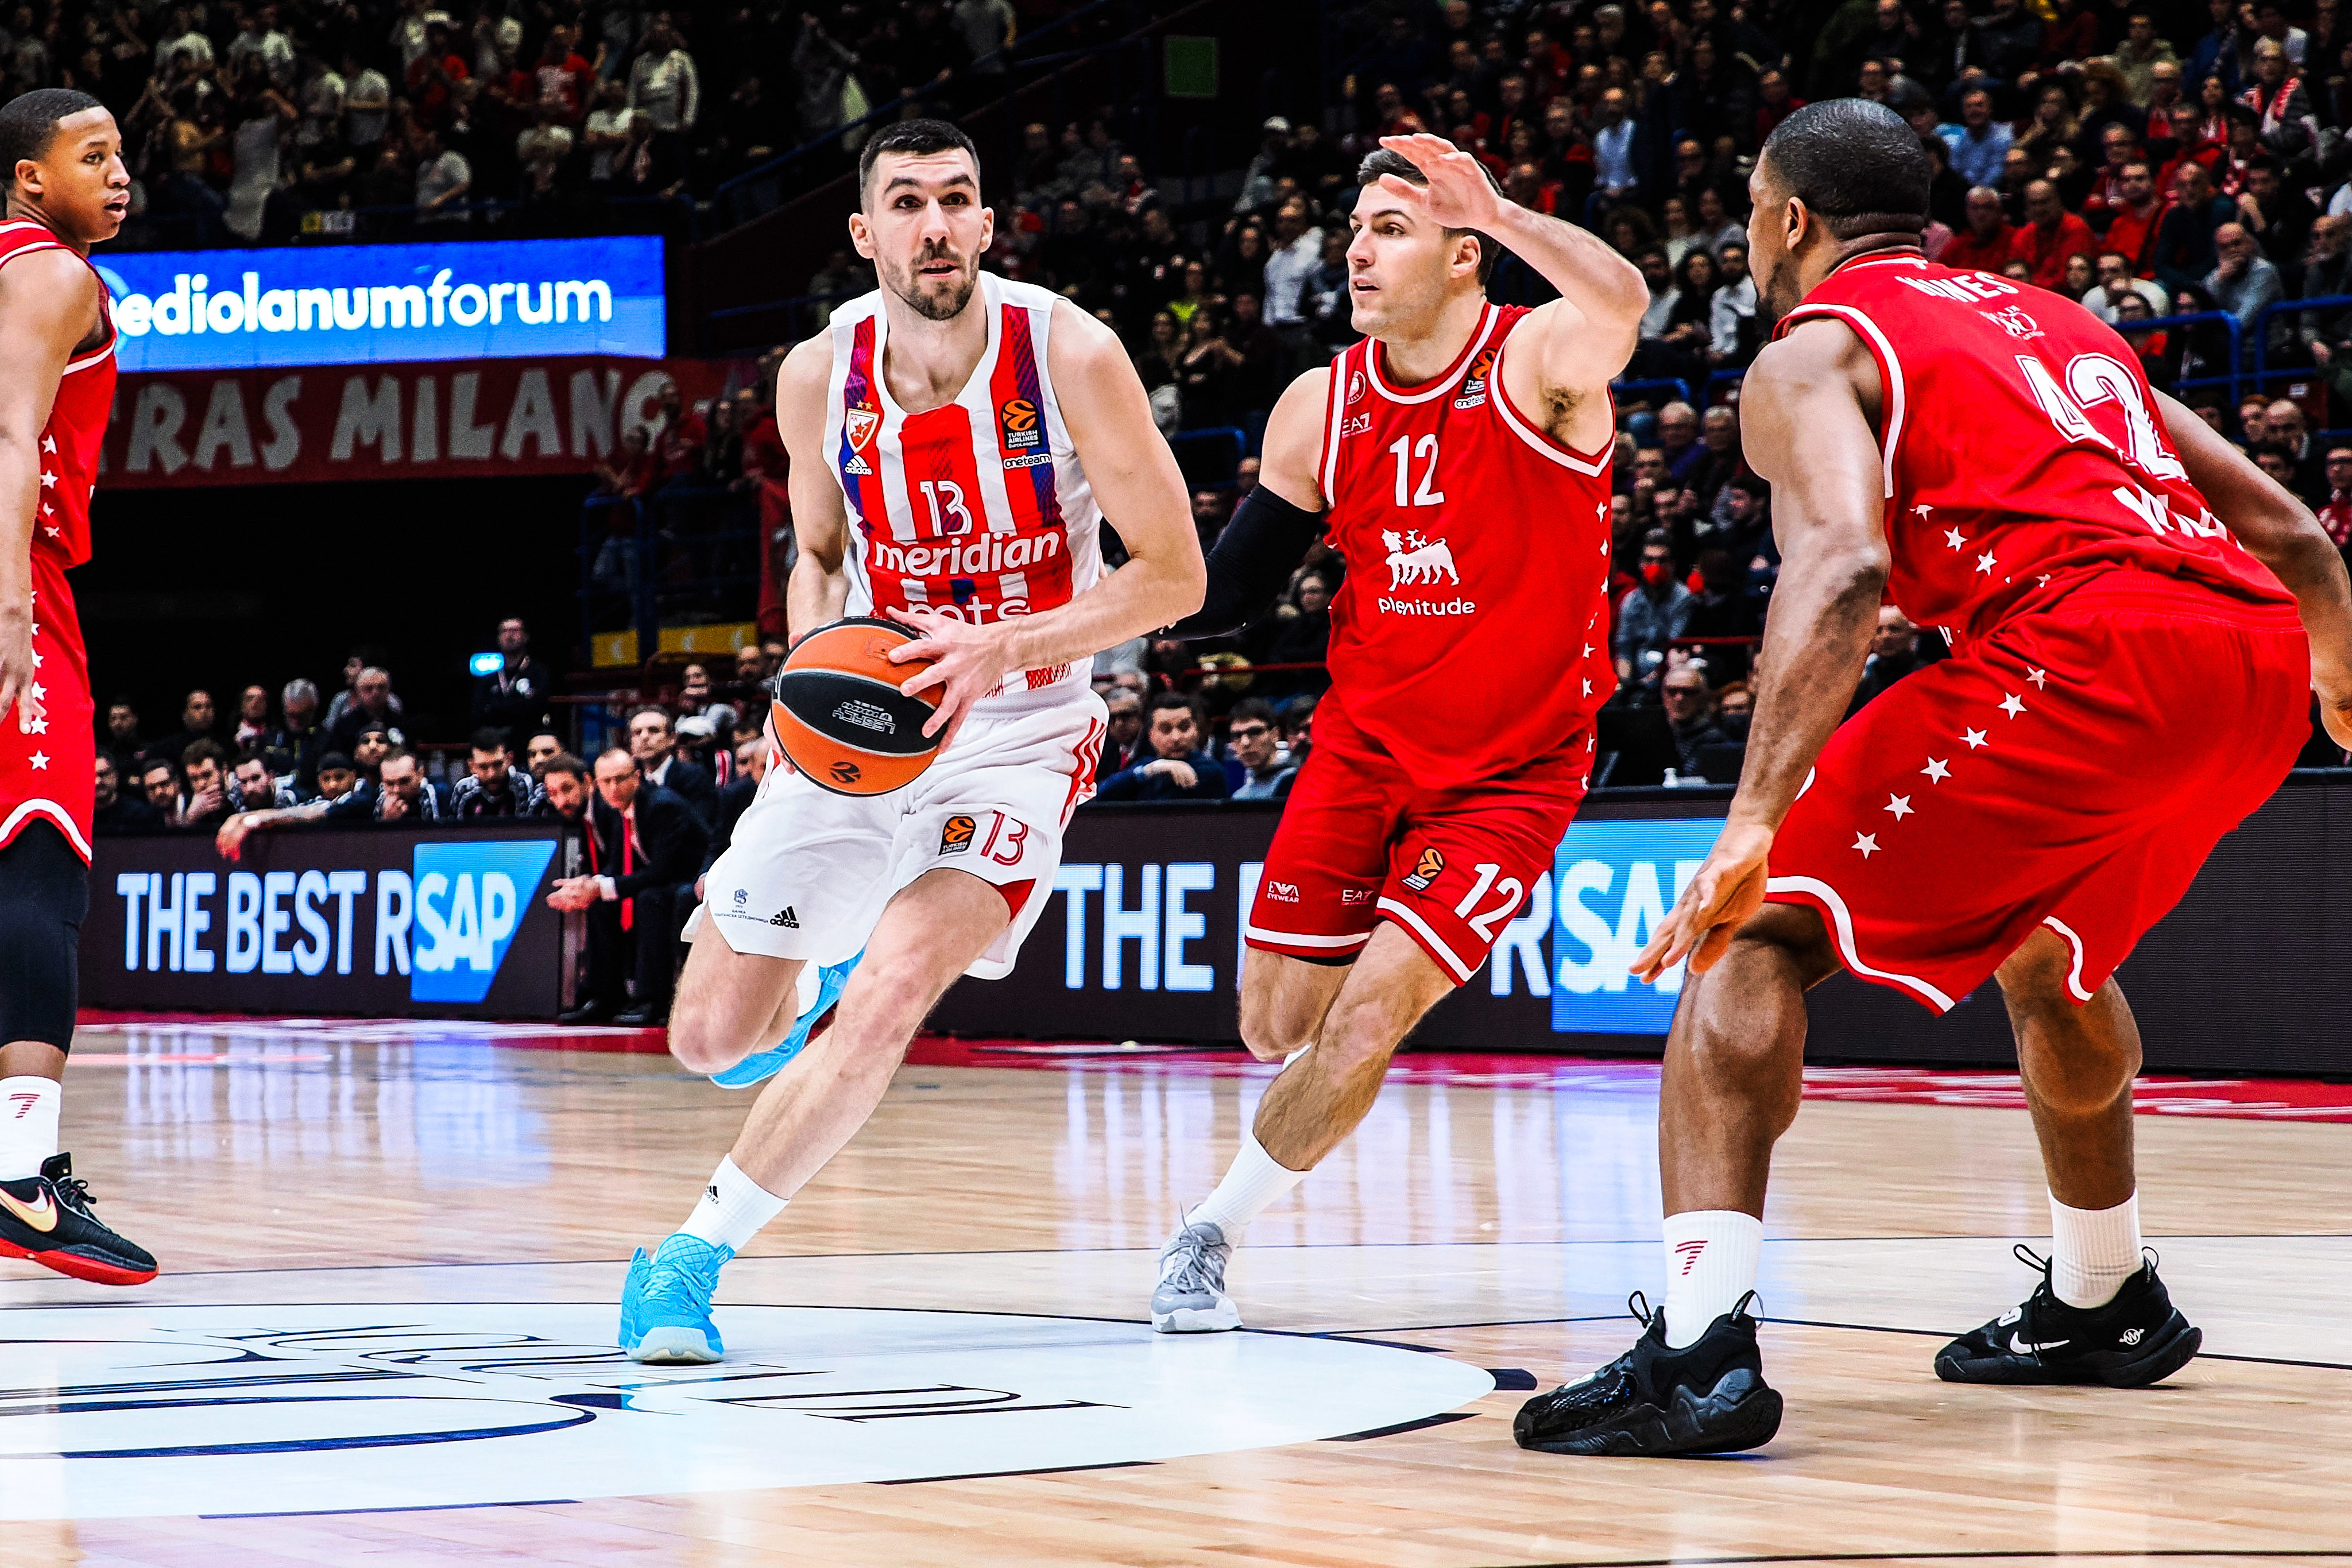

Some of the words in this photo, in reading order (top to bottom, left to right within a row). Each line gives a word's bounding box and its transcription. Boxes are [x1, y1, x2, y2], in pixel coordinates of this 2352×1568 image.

[109, 270, 613, 336] ediolanumforum
[1894, 272, 2019, 303] HINES
[99, 373, 303, 473] RAS
[1007, 429, 1038, 438] TURKISH
[1008, 435, 1038, 444] AIRLINES
[2014, 352, 2192, 486] 42
[845, 466, 873, 475] adidas
[1005, 455, 1050, 468] oneteam
[1389, 433, 1445, 507] 12
[919, 480, 973, 536] 13
[874, 530, 1059, 576] meridian
[1378, 597, 1476, 616] plenitude
[980, 809, 1028, 866] 13
[1267, 892, 1299, 904] EYEWEAR
[1342, 889, 1374, 902] EA7
[1454, 863, 1523, 944] 12
[117, 869, 216, 972] THE
[226, 869, 366, 976] BEST
[415, 870, 518, 972] SAP
[769, 918, 800, 929] adidas
[1053, 862, 1214, 992] THE
[689, 1383, 1133, 1423] DI
